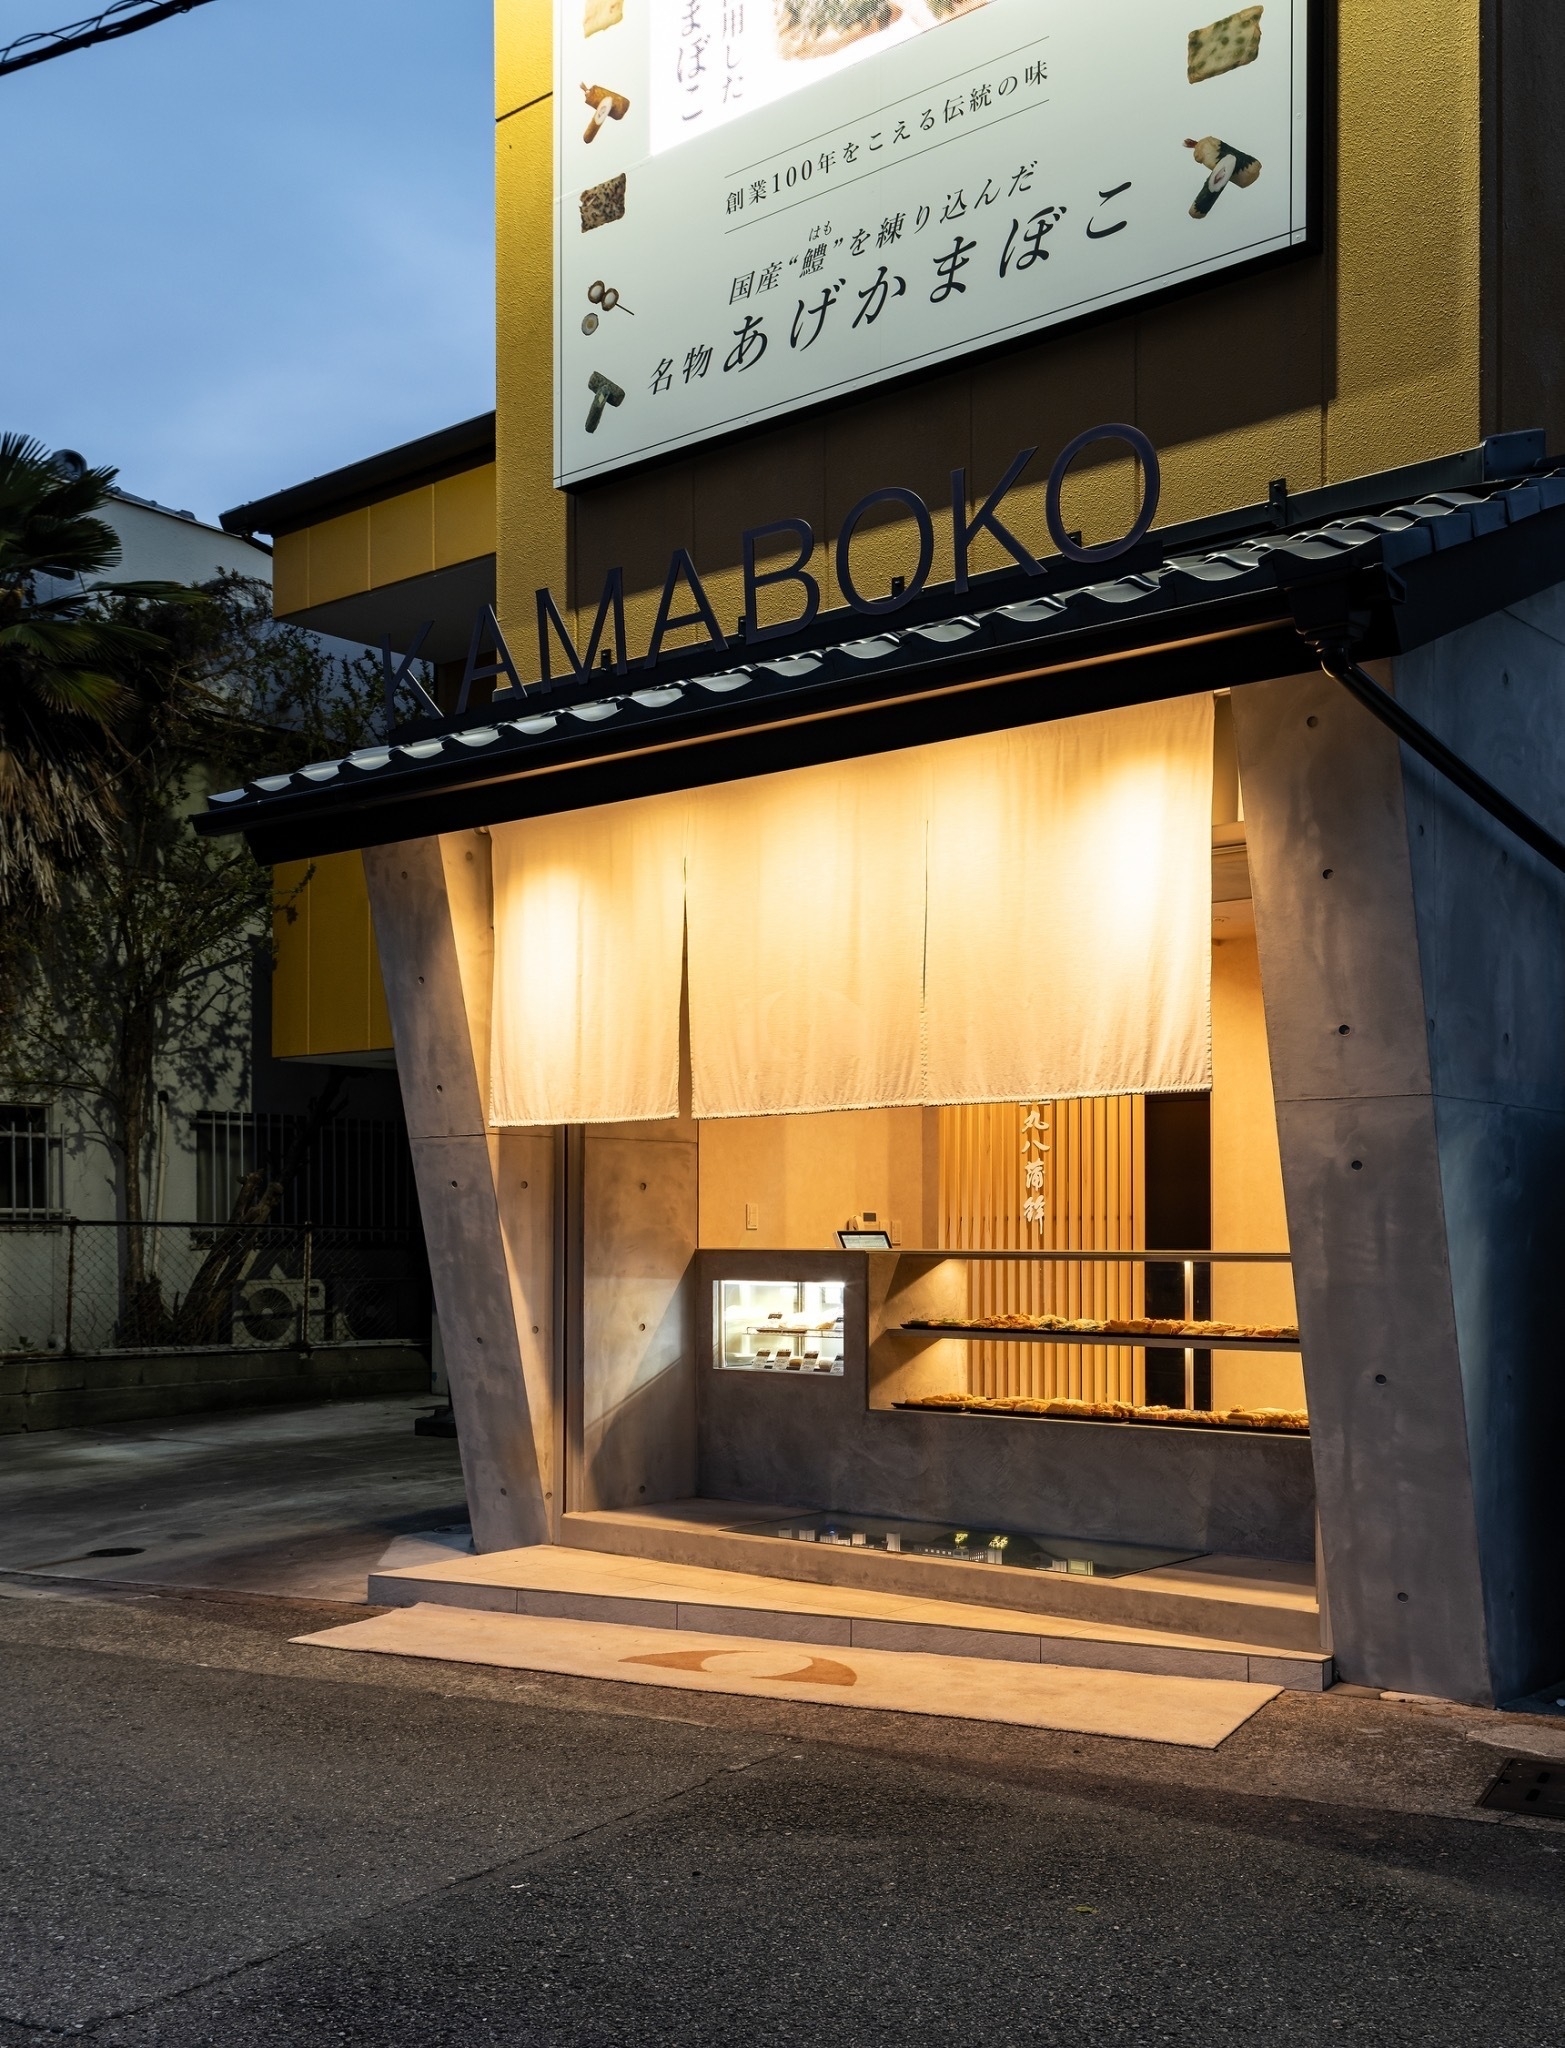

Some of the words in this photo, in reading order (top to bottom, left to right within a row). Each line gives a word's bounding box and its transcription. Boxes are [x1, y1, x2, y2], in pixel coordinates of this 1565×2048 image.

[724, 60, 1048, 215] 創業100年をこえる伝統の味
[808, 220, 832, 242] はも
[382, 423, 1161, 731] KAMABOKO
